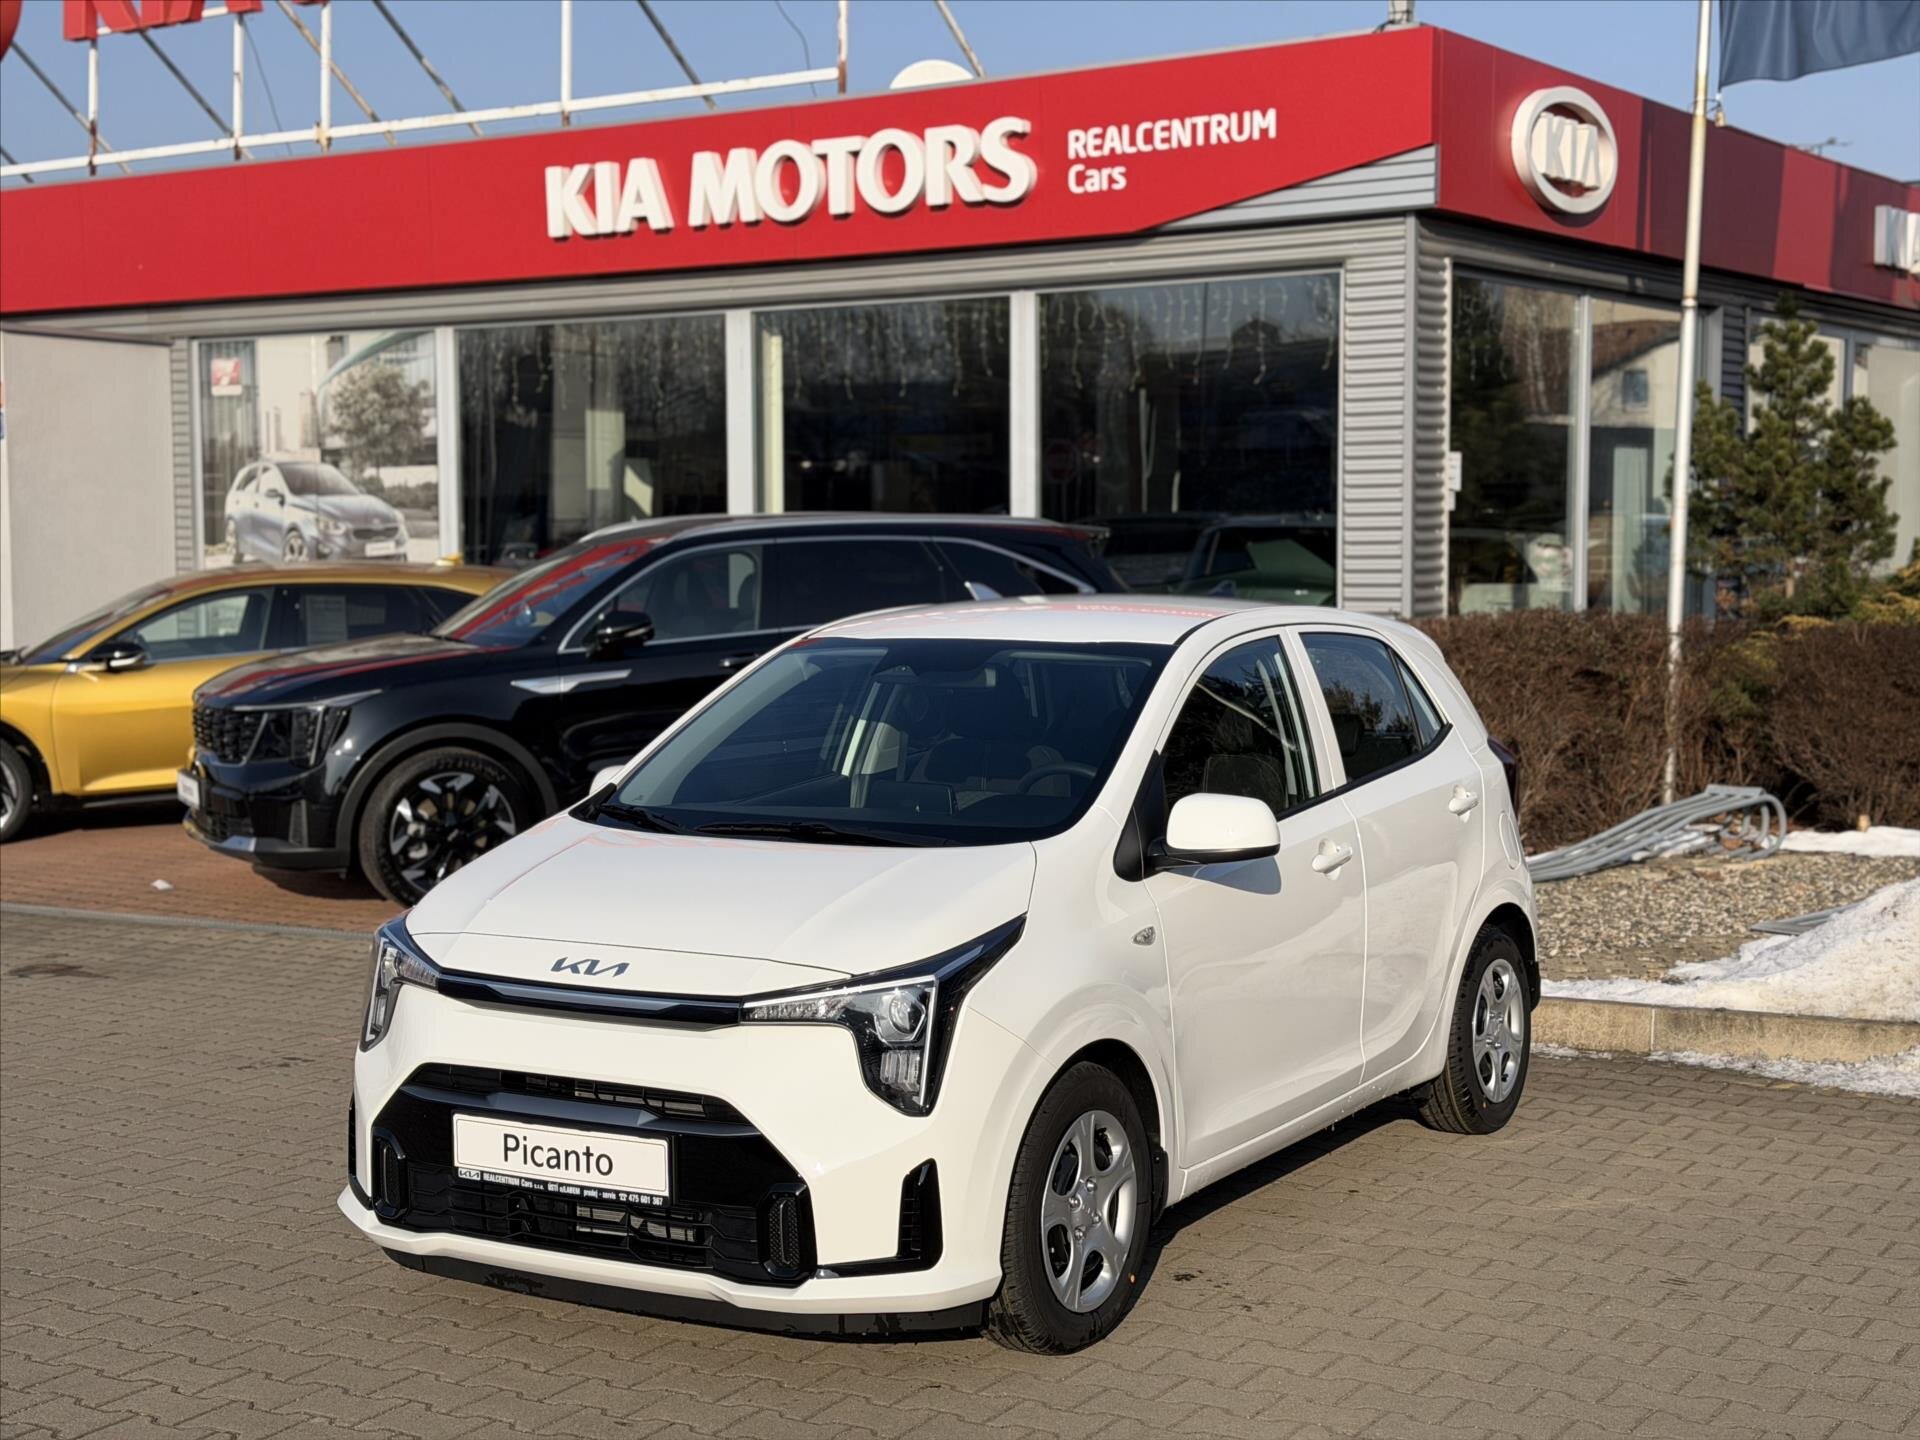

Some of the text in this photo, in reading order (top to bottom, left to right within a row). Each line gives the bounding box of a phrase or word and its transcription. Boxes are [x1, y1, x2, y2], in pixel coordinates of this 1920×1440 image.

[1067, 108, 1277, 160] REALCENTRUM
[1540, 111, 1603, 188] KIA
[545, 116, 1037, 238] KIA MOTORS
[1067, 163, 1127, 194] Cars
[551, 956, 630, 978] KIA
[503, 1133, 613, 1176] Picanto
